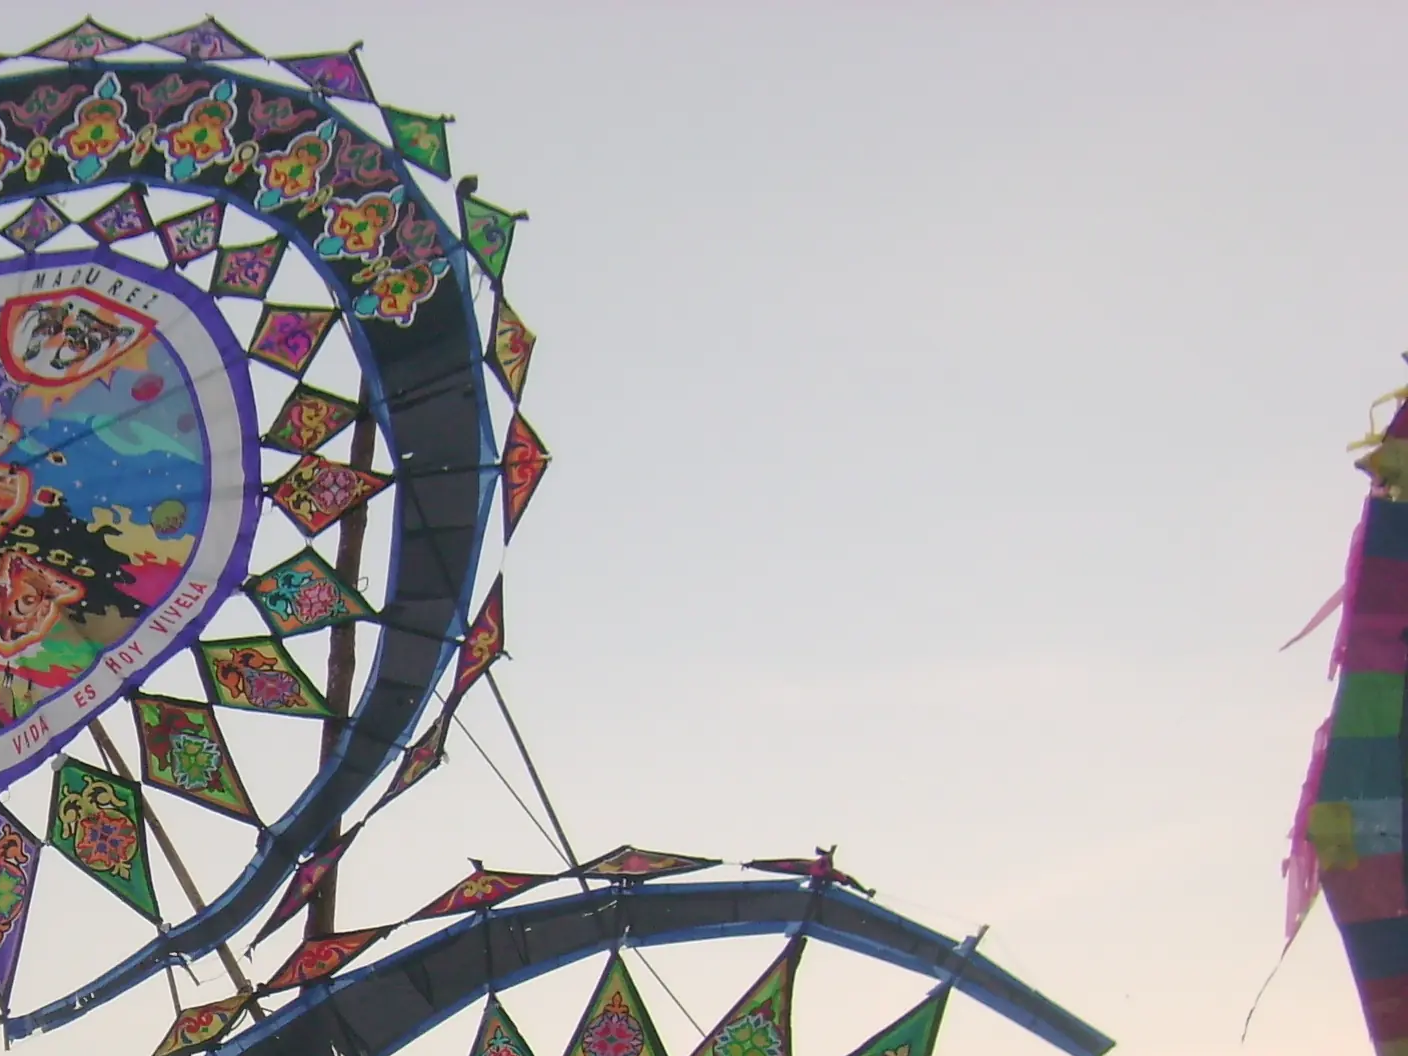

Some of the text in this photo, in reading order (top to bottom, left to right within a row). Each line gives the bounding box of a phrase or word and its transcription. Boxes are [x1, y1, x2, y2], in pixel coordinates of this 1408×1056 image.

[12, 715, 50, 755] VIDA
[73, 683, 97, 709] ES
[104, 640, 144, 675] HOY
[149, 580, 208, 636] VIVELA
